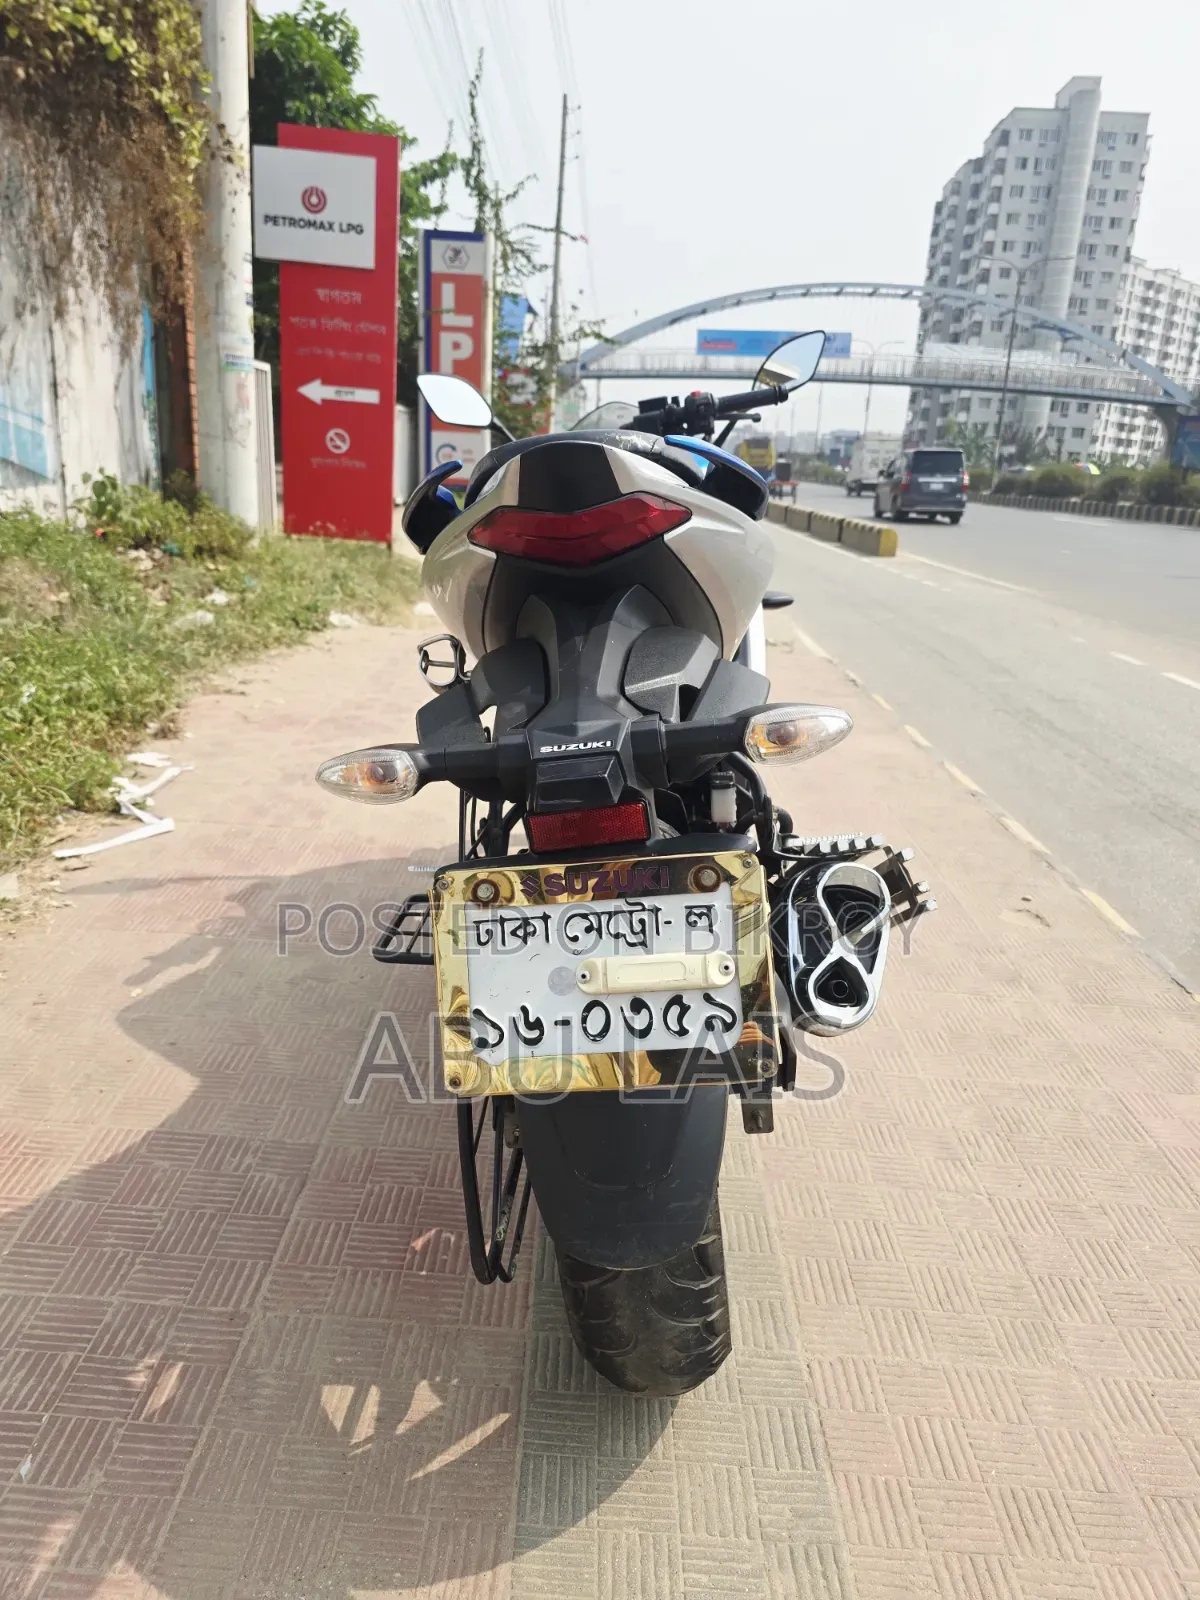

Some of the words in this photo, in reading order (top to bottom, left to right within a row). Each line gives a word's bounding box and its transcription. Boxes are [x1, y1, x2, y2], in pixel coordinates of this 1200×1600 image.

[263, 214, 335, 232] PETROMAX
[339, 223, 364, 235] LPG
[439, 282, 475, 375] LP
[539, 740, 612, 753] SUZUKI
[544, 866, 669, 896] SUZUKI
[473, 911, 551, 947] ঢাকা
[684, 903, 716, 935] ল
[471, 992, 738, 1050] ১৬-০৩৫৯
